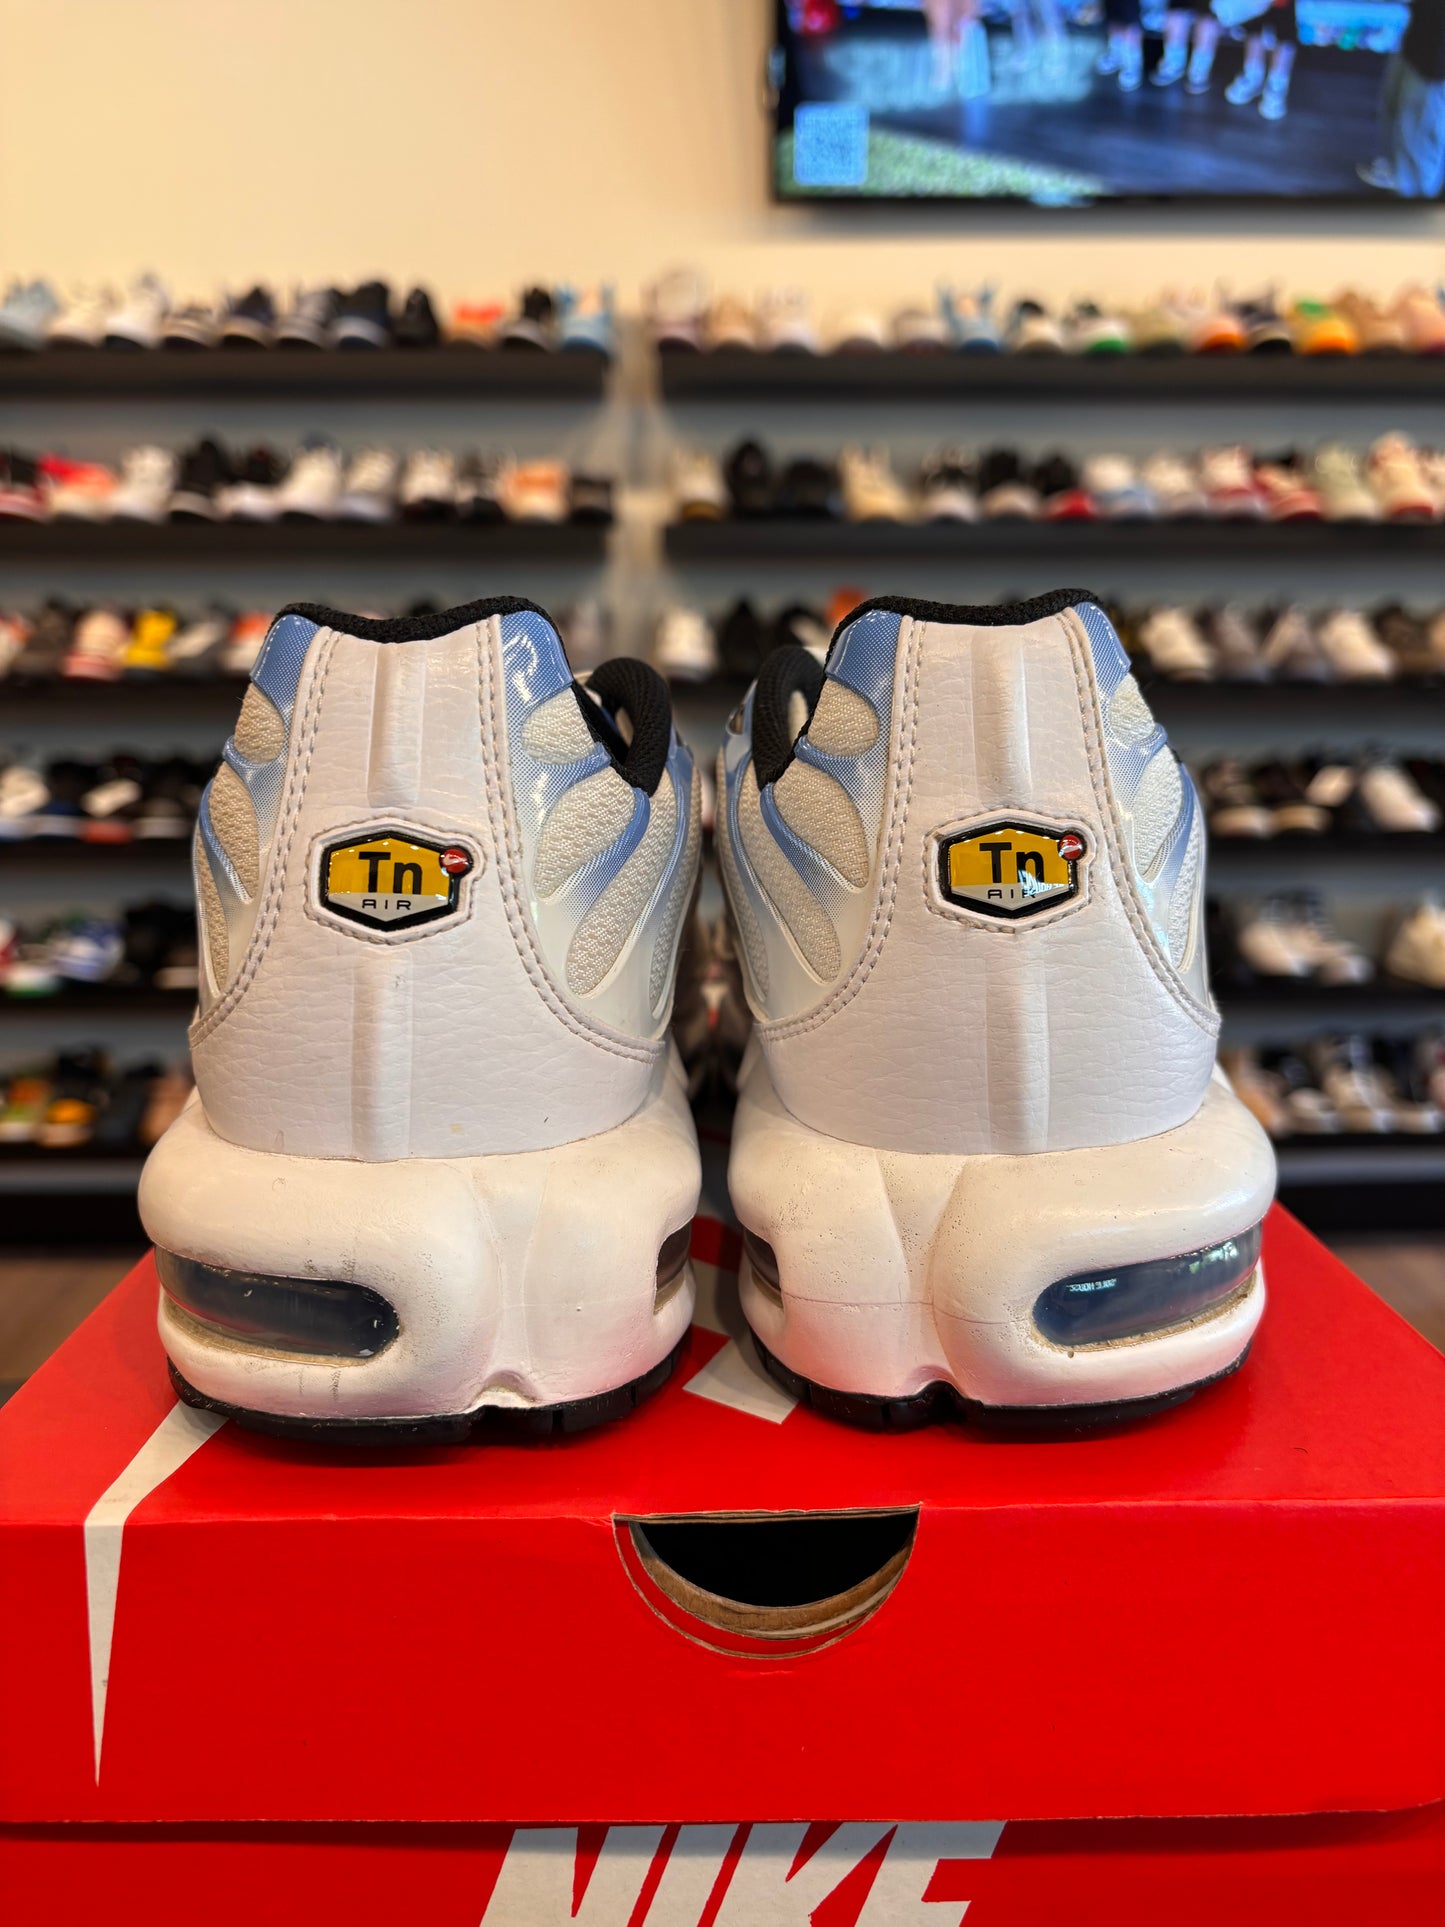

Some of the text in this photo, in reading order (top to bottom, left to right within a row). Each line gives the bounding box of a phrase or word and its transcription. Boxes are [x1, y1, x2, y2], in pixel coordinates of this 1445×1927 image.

[358, 851, 422, 895] Tn
[979, 842, 1045, 884] Tn
[362, 899, 411, 910] AIR
[479, 1821, 1007, 1927] NIKE
